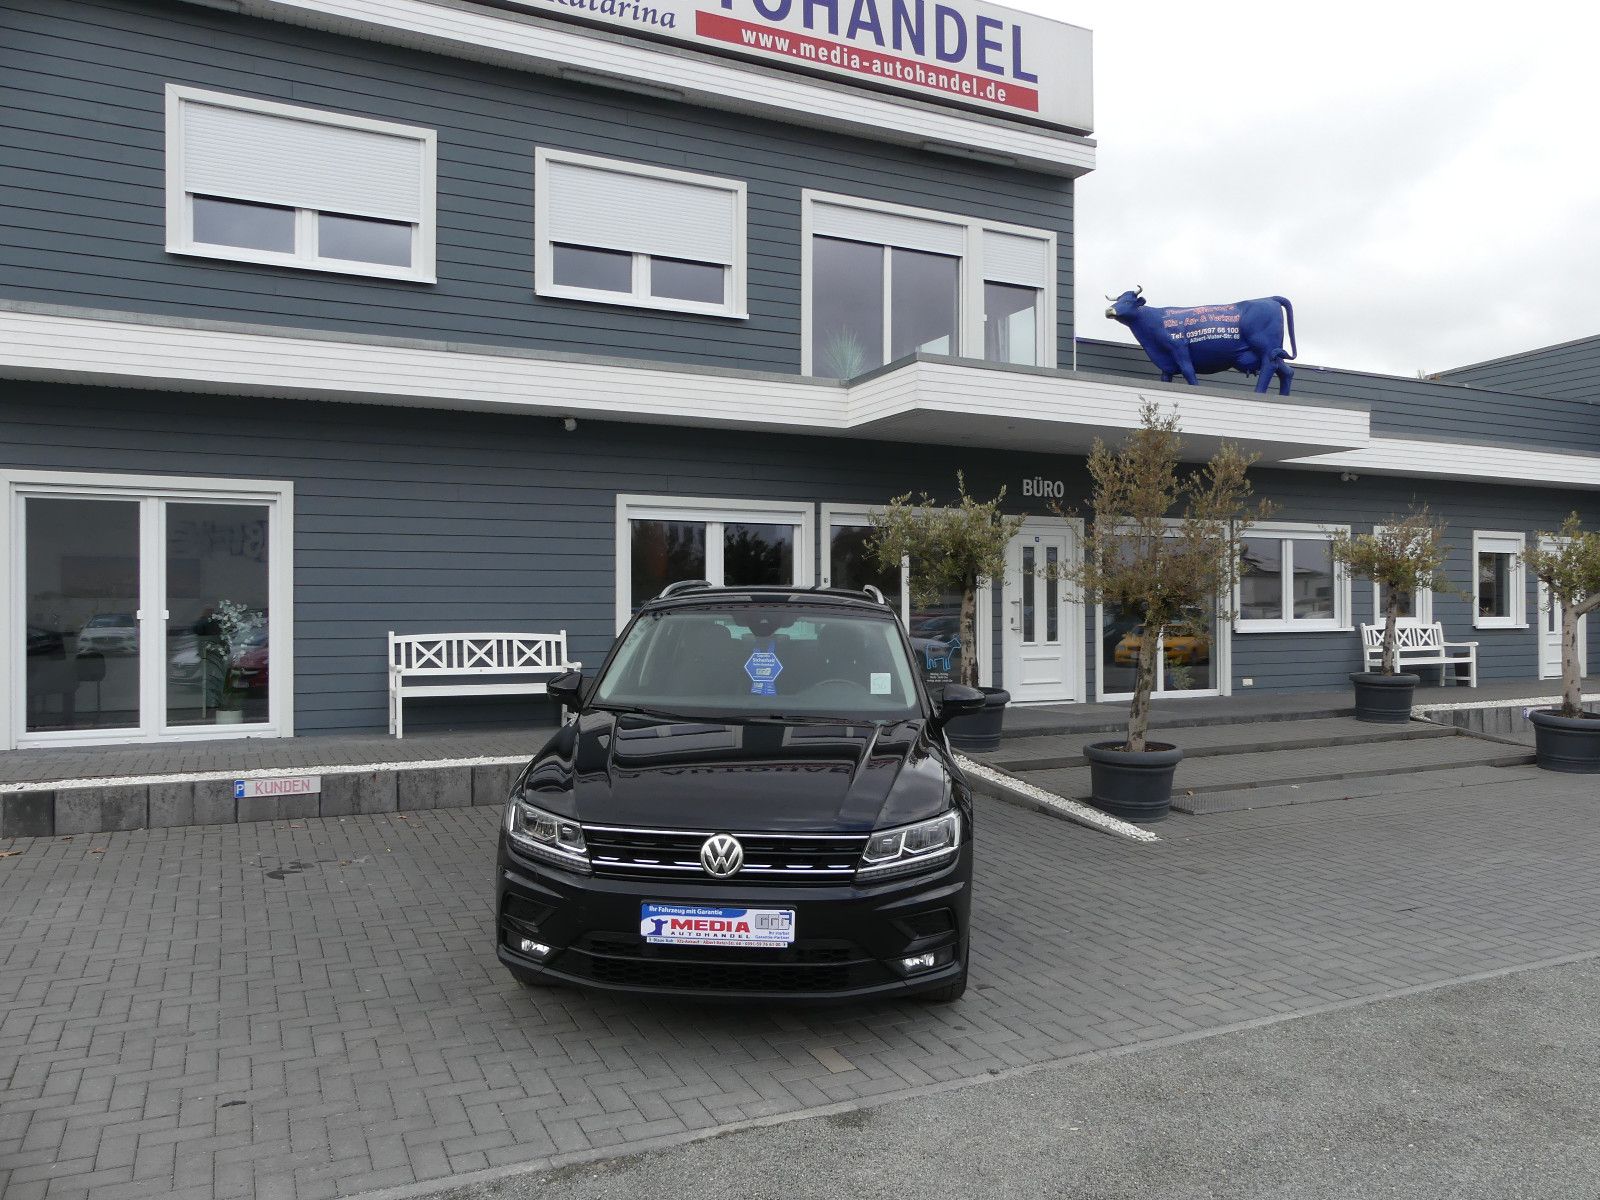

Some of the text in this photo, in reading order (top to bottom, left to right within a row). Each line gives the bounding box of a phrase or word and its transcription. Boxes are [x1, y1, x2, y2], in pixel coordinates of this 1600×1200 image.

[547, 0, 676, 29] atarina
[720, 0, 1039, 85] HANDEL
[741, 28, 1007, 102] www.media-autohandel.de
[1022, 476, 1065, 498] BÜRO
[236, 779, 310, 795] P KUNDEN
[658, 906, 685, 915] Fahrzeug
[696, 908, 723, 916] Garantie
[670, 918, 751, 934] MEDIA
[670, 931, 751, 939] AUTOHANDEL
